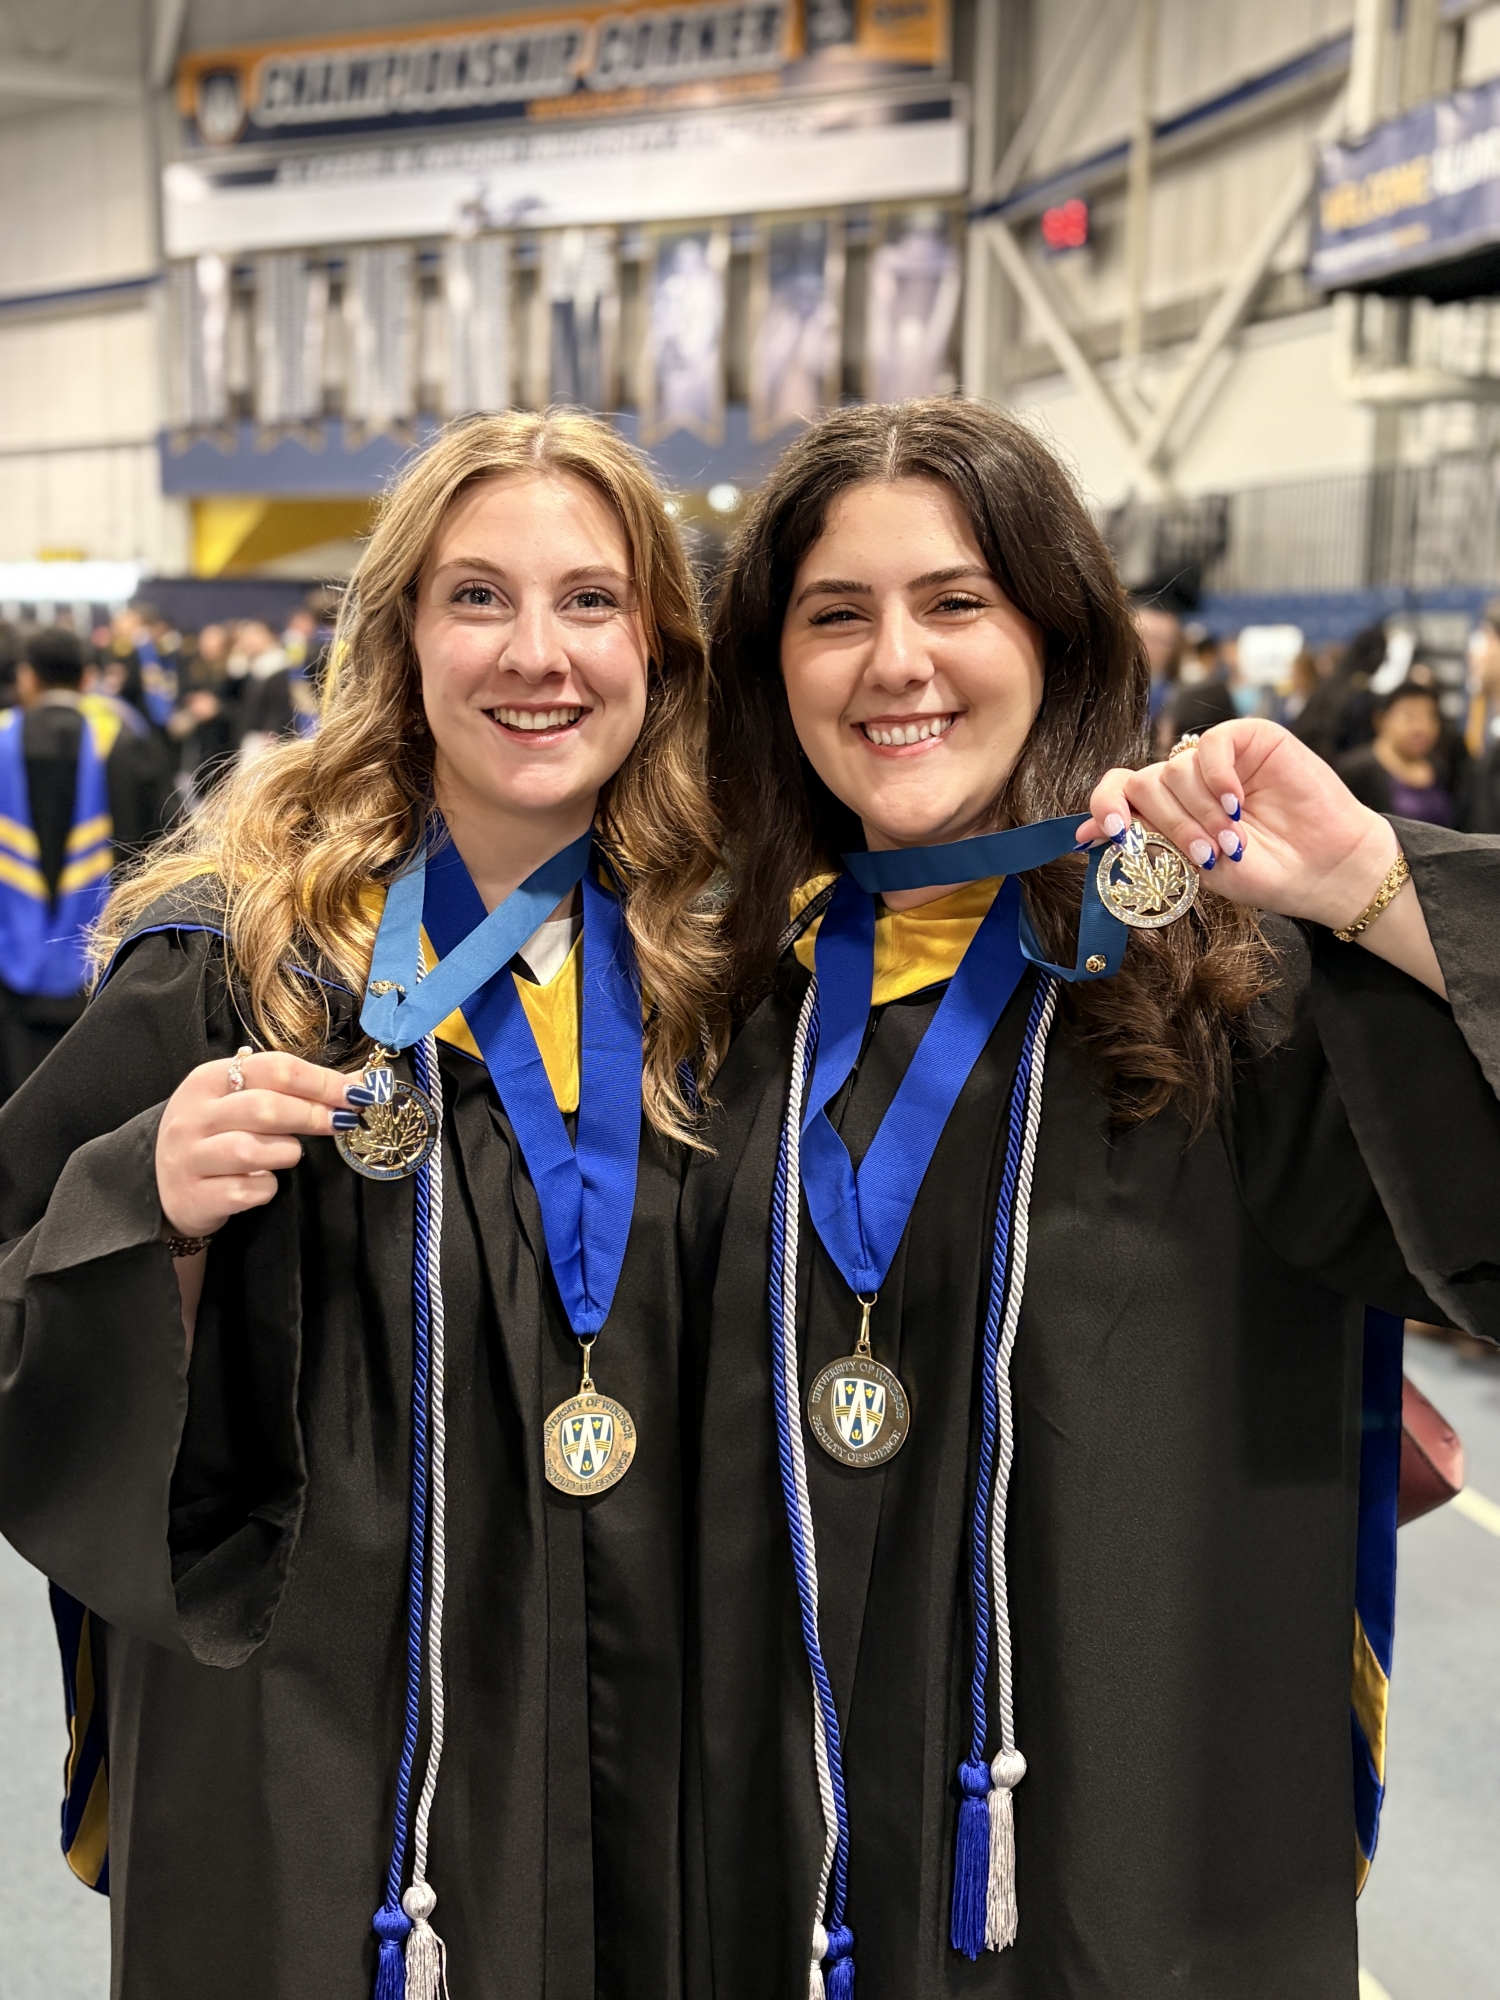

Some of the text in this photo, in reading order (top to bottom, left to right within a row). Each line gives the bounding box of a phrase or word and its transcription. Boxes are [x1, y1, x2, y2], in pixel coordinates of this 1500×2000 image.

[812, 1361, 857, 1404] UNIVERSITY
[859, 1362, 875, 1373] OF
[543, 1398, 633, 1448] UNIVERSITY OF WINDSOR
[847, 1452, 863, 1462] OF
[863, 1429, 901, 1463] SCIENCE
[580, 1481, 595, 1491] OF
[596, 1450, 631, 1486] SCIENCE
